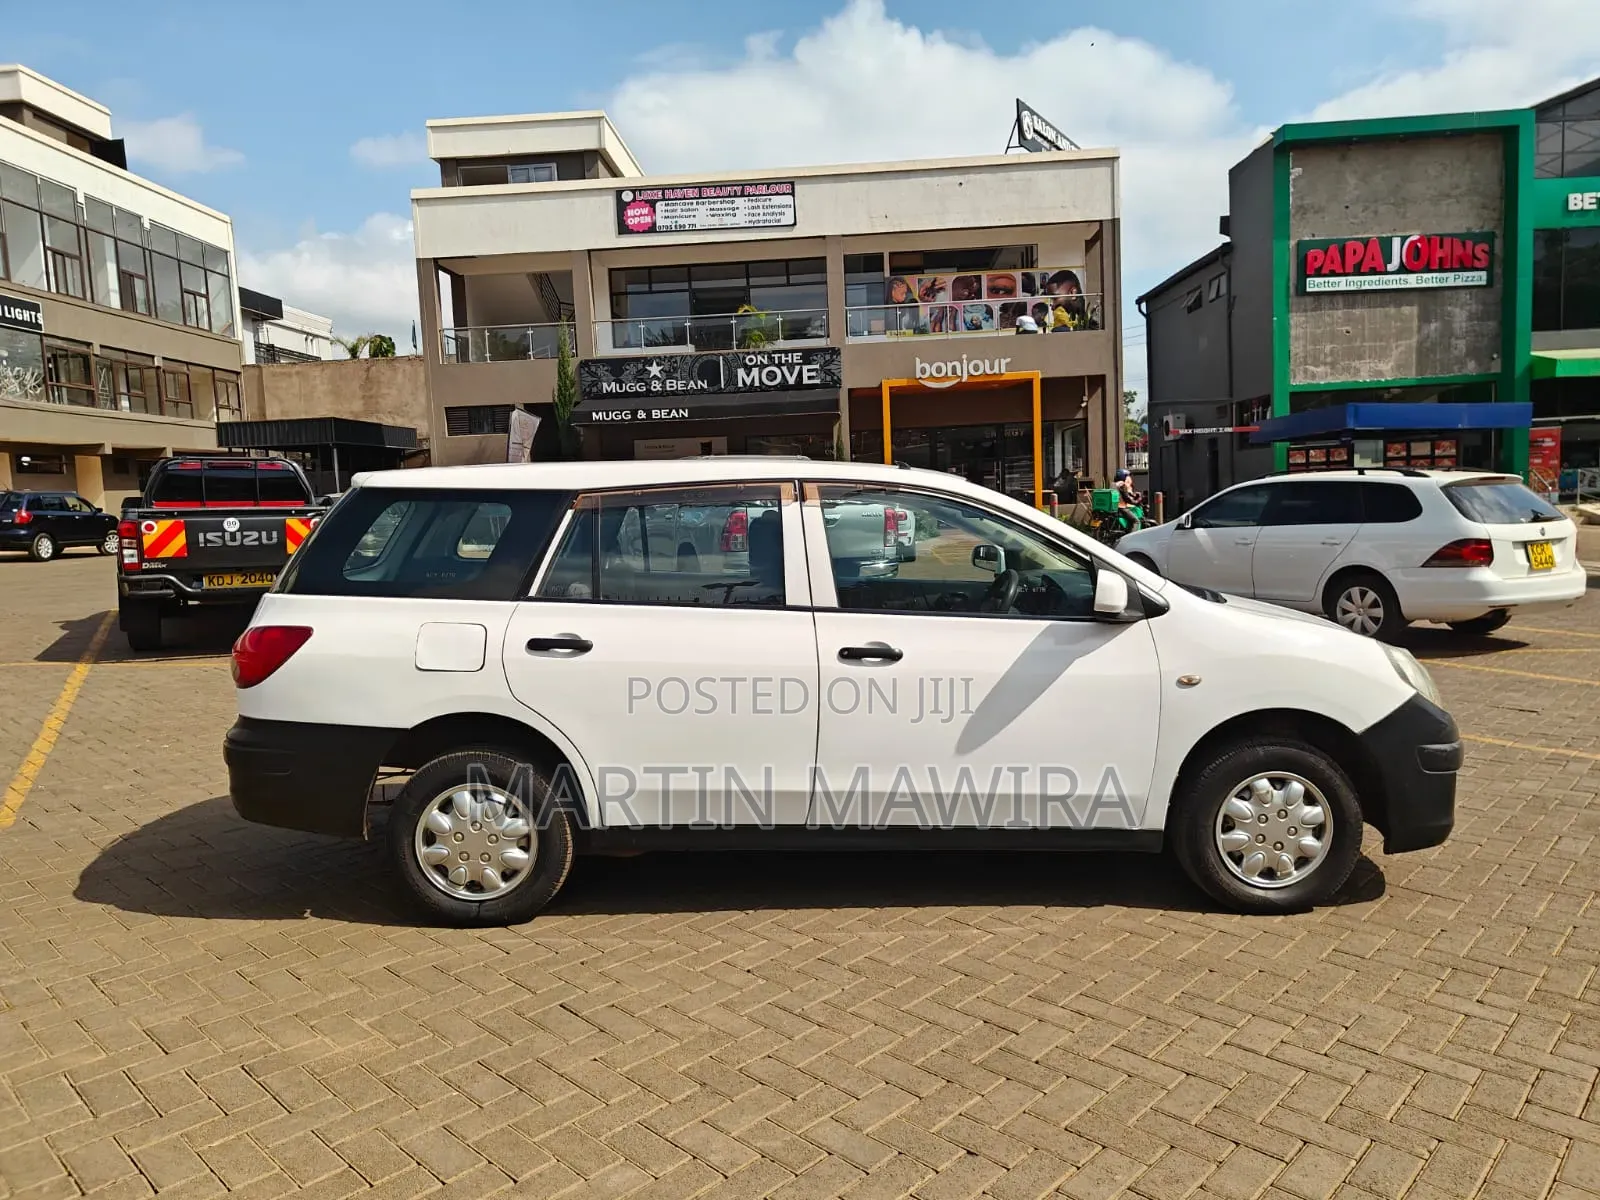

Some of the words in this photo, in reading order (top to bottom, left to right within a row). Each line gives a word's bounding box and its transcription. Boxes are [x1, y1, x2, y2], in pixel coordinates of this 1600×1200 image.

[635, 190, 663, 200] LUXE
[664, 188, 699, 199] HAVEN
[702, 186, 742, 197] BEAUTY
[744, 184, 792, 195] PARLOUR
[1567, 192, 1600, 211] BE
[627, 207, 649, 217] NOW
[1307, 279, 1342, 290] Better
[1345, 276, 1413, 290] Ingredients.
[1415, 274, 1449, 286] Better
[4, 304, 43, 325] LIGHTS
[745, 355, 768, 366] ON
[771, 353, 803, 364] THE
[737, 364, 821, 388] MOVE
[915, 354, 1011, 382] bonjour
[650, 380, 662, 392] &
[592, 410, 632, 421] MUGG
[637, 410, 646, 419] &
[652, 408, 689, 419] BEAN
[199, 531, 278, 547] ISUZU
[207, 575, 234, 587] KDJ
